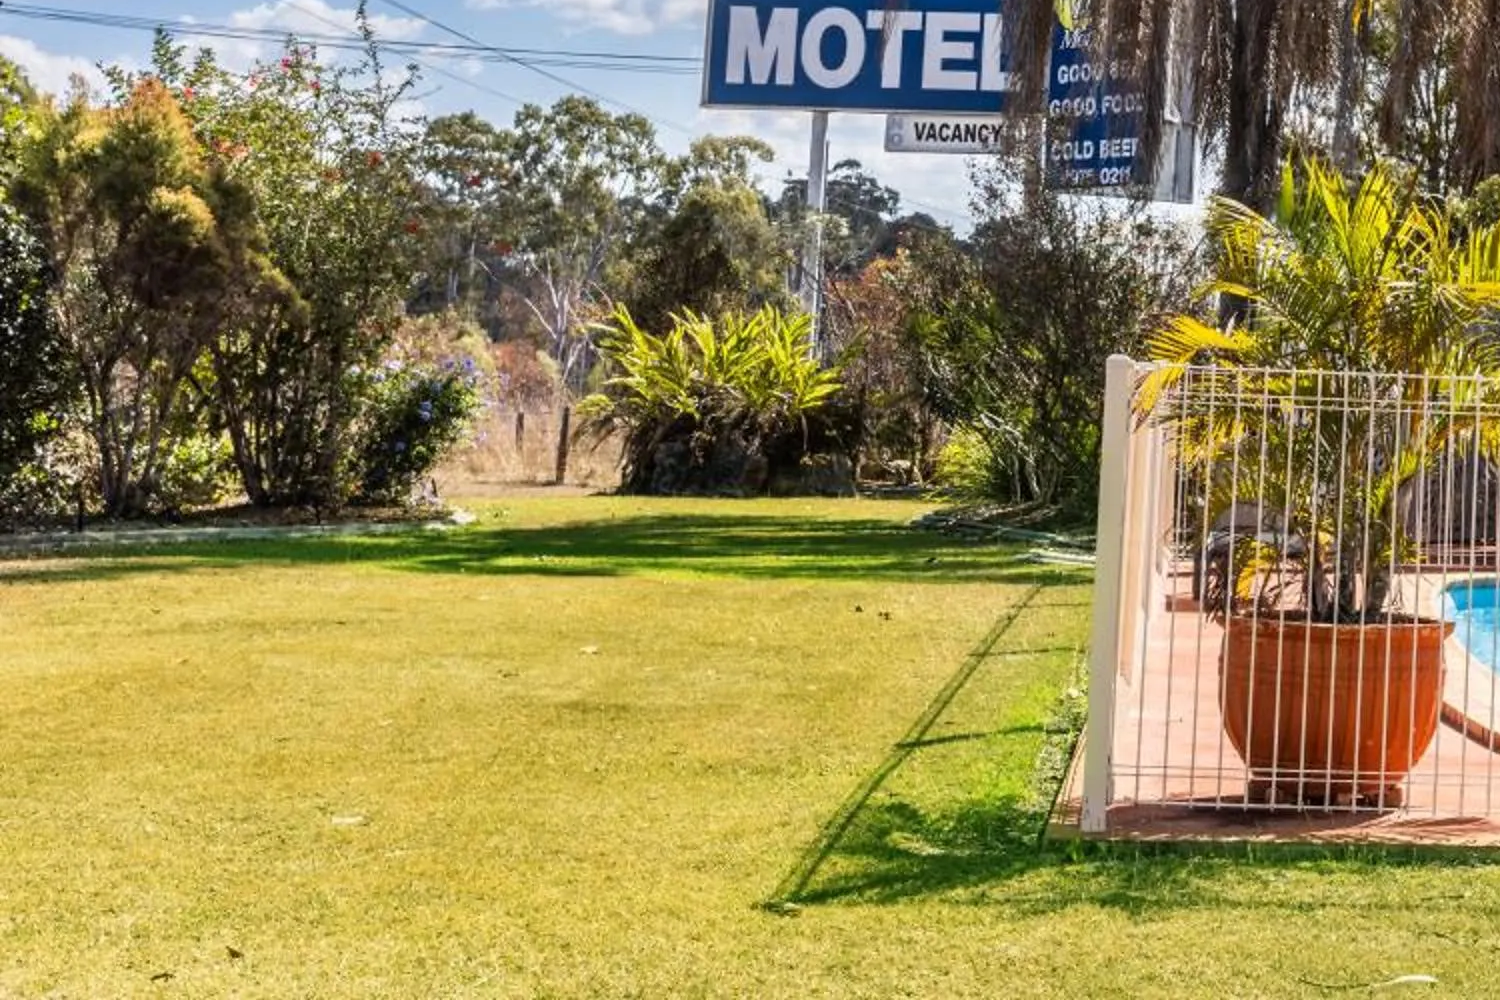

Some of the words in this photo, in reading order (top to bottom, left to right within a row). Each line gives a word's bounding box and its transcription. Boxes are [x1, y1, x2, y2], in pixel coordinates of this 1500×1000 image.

[725, 5, 1012, 91] MOTEL
[1049, 95, 1097, 118] GOOD
[914, 121, 1004, 144] VACANCY
[1051, 139, 1095, 161] COLD
